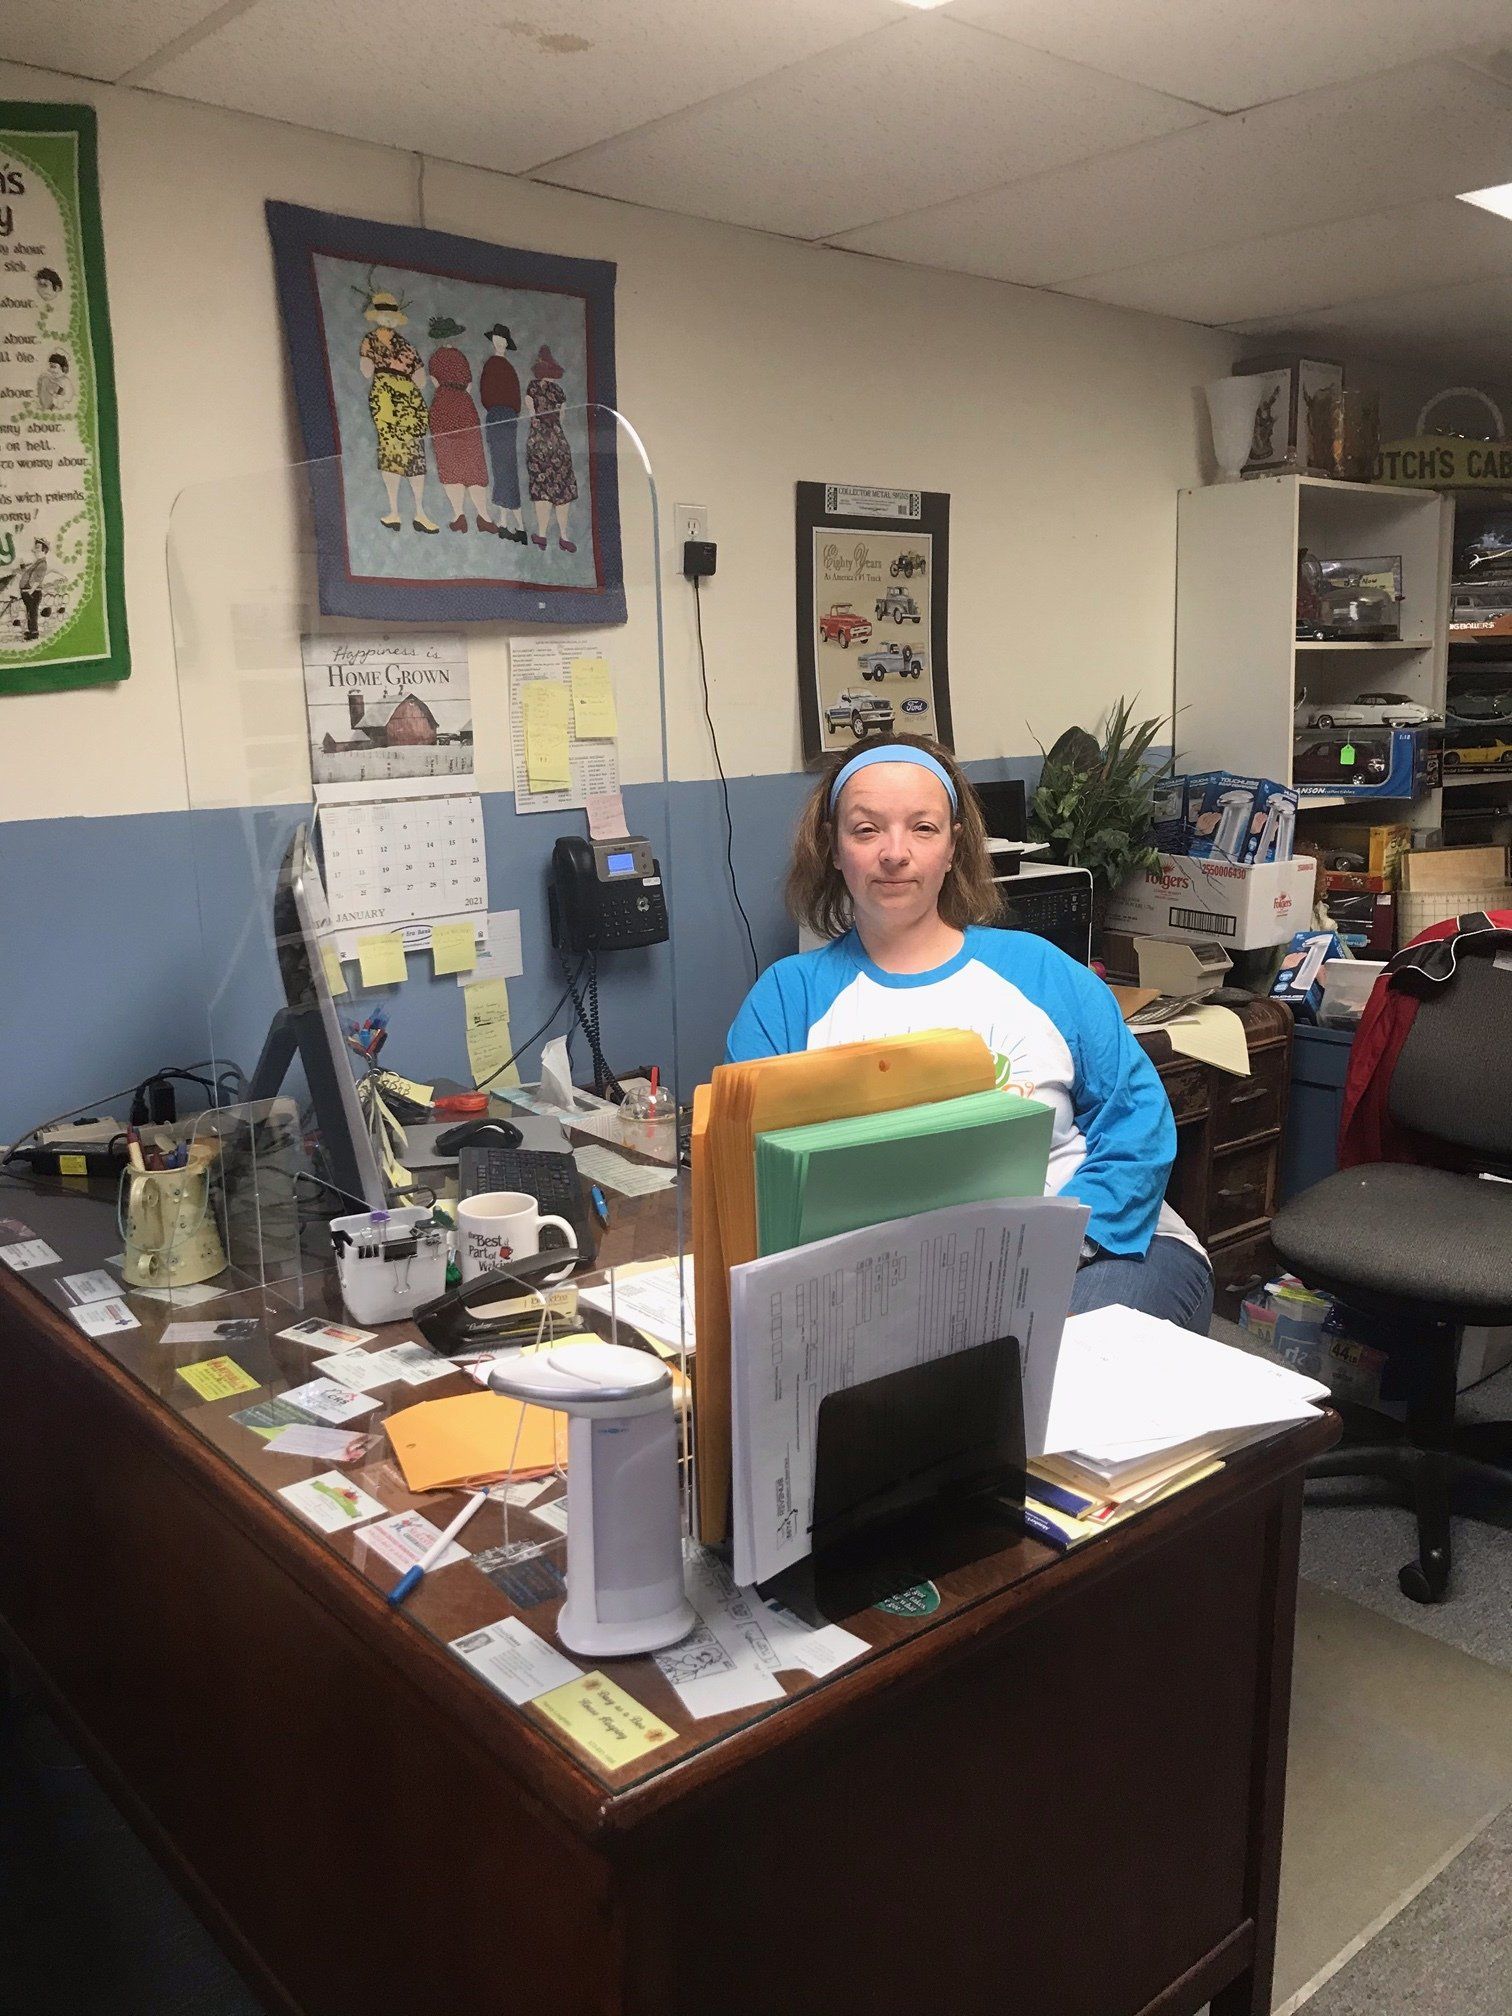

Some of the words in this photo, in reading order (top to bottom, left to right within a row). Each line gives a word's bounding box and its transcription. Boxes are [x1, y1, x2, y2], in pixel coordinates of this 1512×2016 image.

[26, 439, 55, 451] hell.
[17, 459, 53, 470] worry
[15, 491, 42, 504] with
[332, 645, 418, 666] Happiness
[425, 646, 442, 659] is
[328, 664, 382, 688] HOME
[384, 663, 451, 686] GROWN
[904, 700, 924, 712] Ford
[356, 827, 361, 835] 4
[465, 896, 483, 907] 2021
[1273, 897, 1292, 910] Folgers
[335, 908, 386, 923] JANUARY
[477, 1235, 503, 1248] Best
[469, 1245, 489, 1259] Part
[488, 1251, 497, 1259] of
